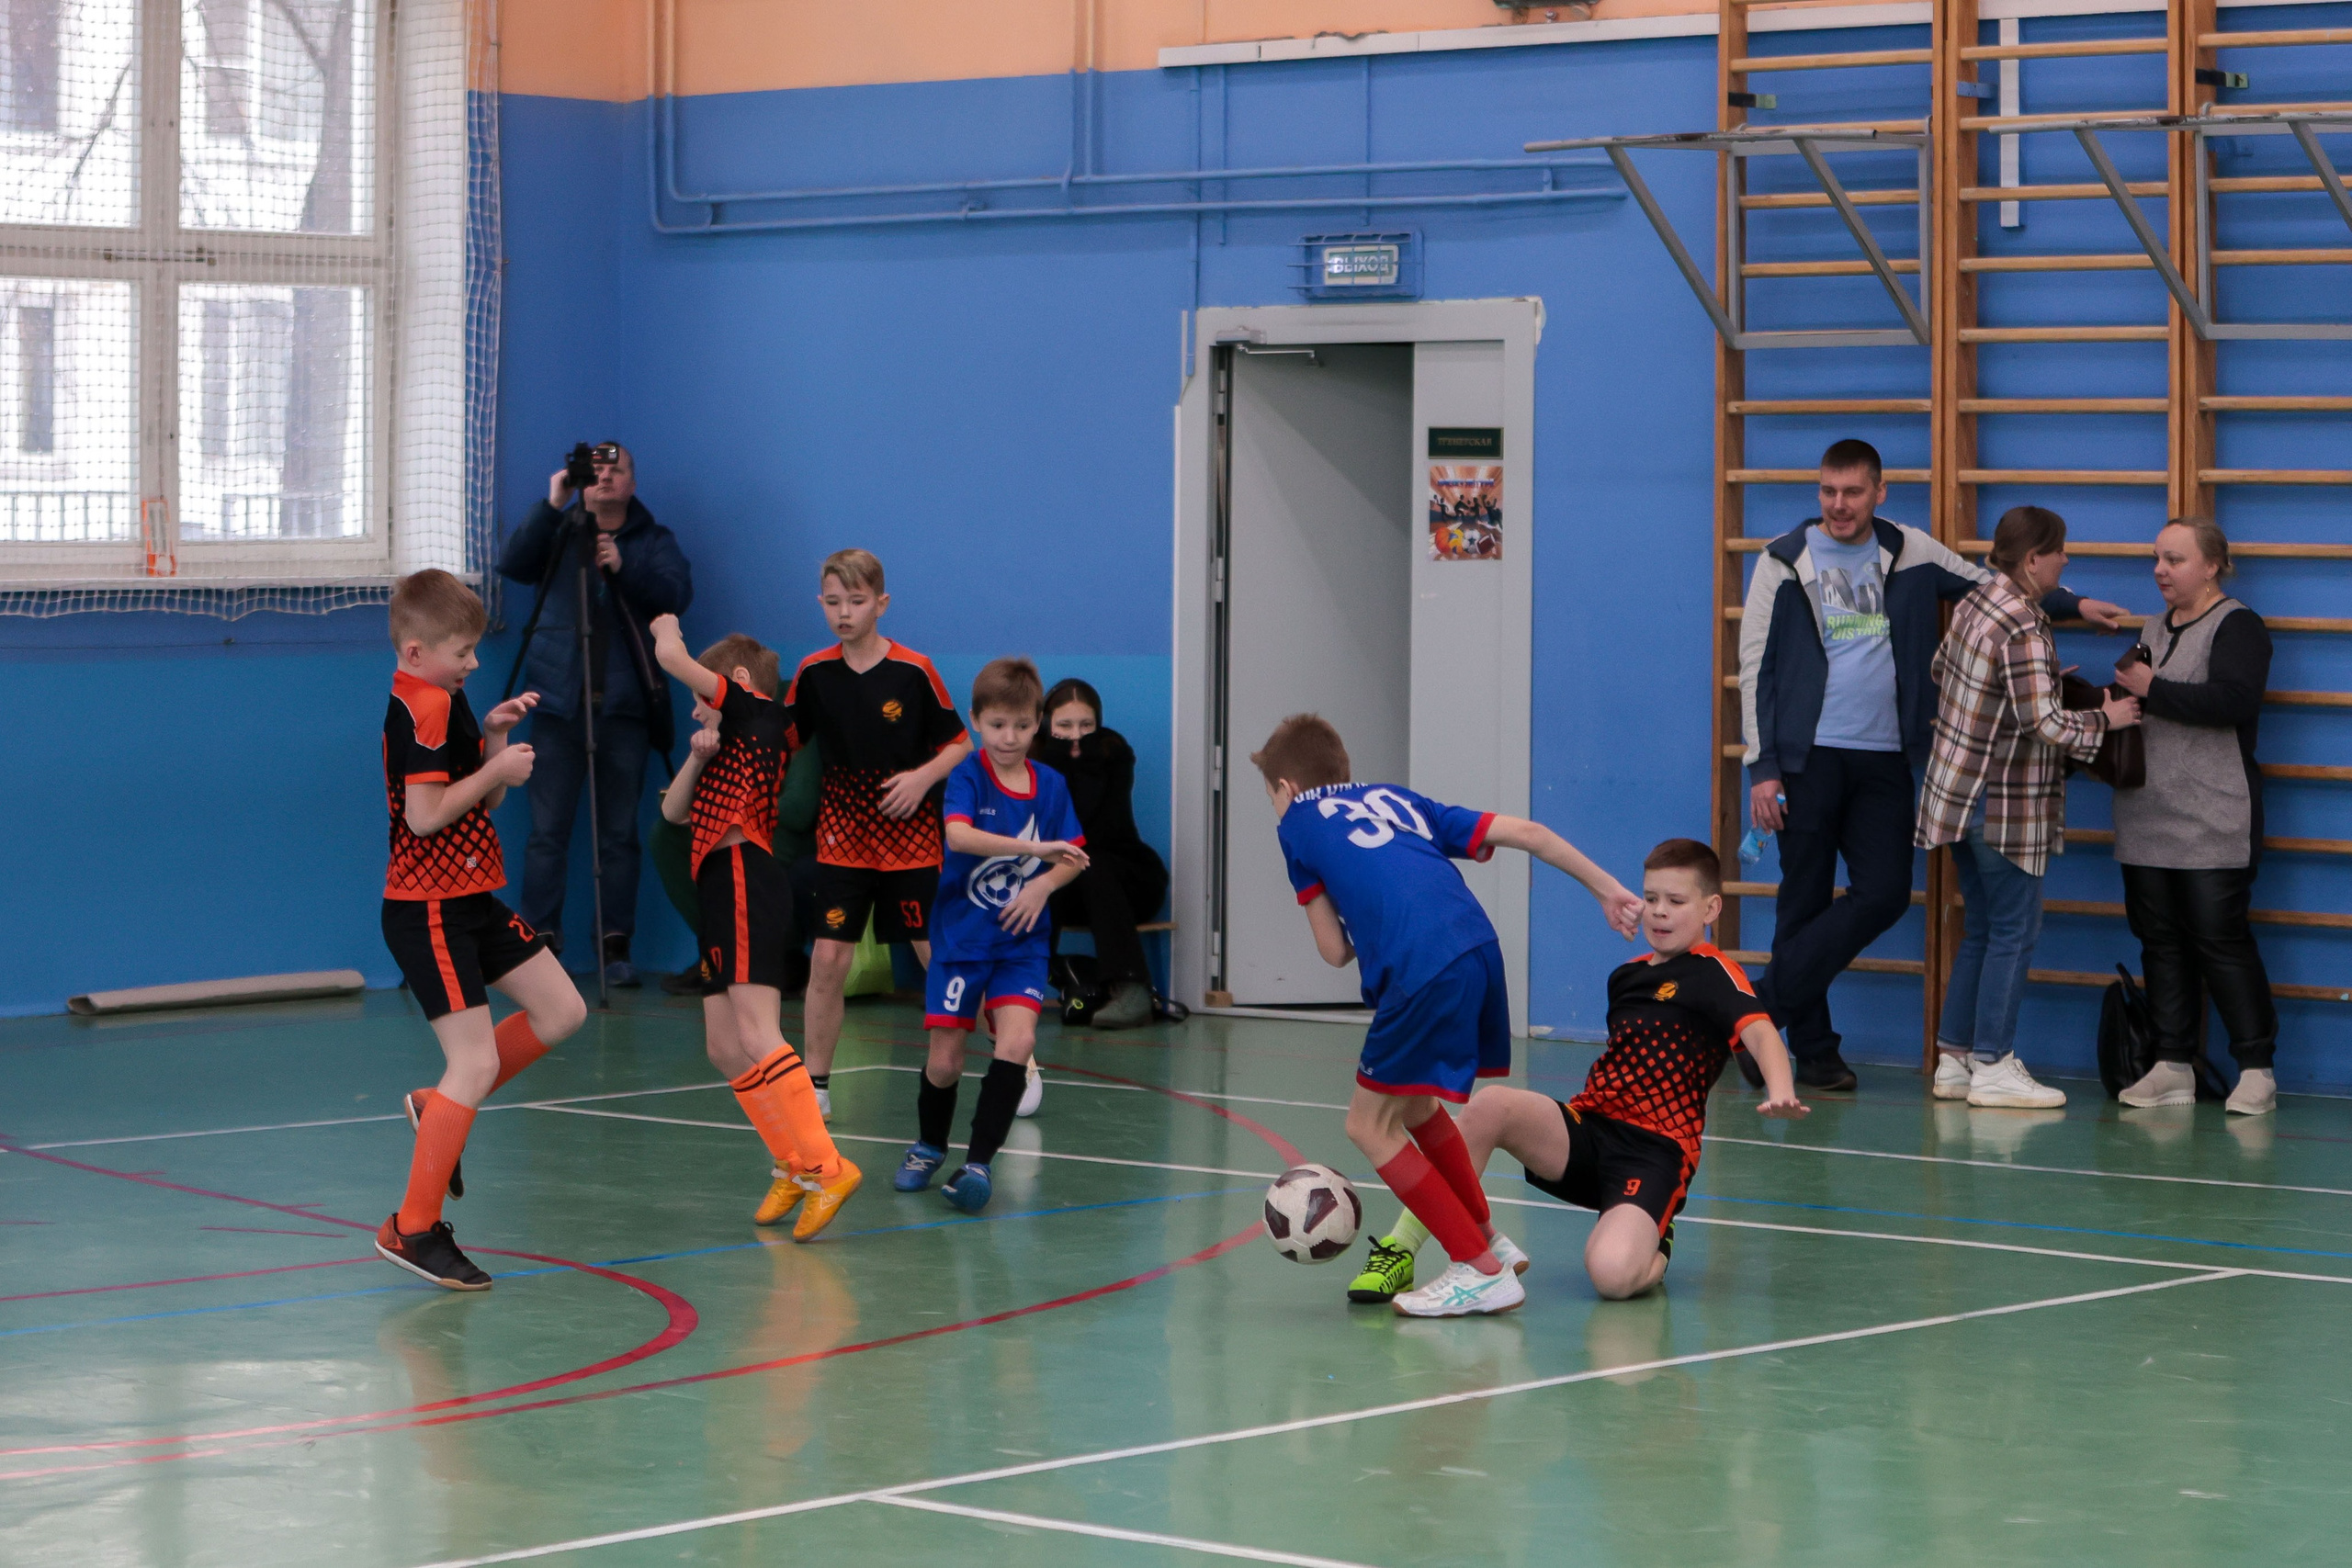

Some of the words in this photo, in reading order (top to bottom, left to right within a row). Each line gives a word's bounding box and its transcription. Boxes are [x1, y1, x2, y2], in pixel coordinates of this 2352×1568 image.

[1329, 255, 1389, 274] ВЫХОД
[1826, 614, 1884, 629] RUNNING
[1831, 625, 1890, 640] DISTRIC
[1317, 788, 1433, 849] 30
[899, 899, 923, 929] 53
[944, 976, 966, 1012] 9
[1623, 1178, 1642, 1196] 9
